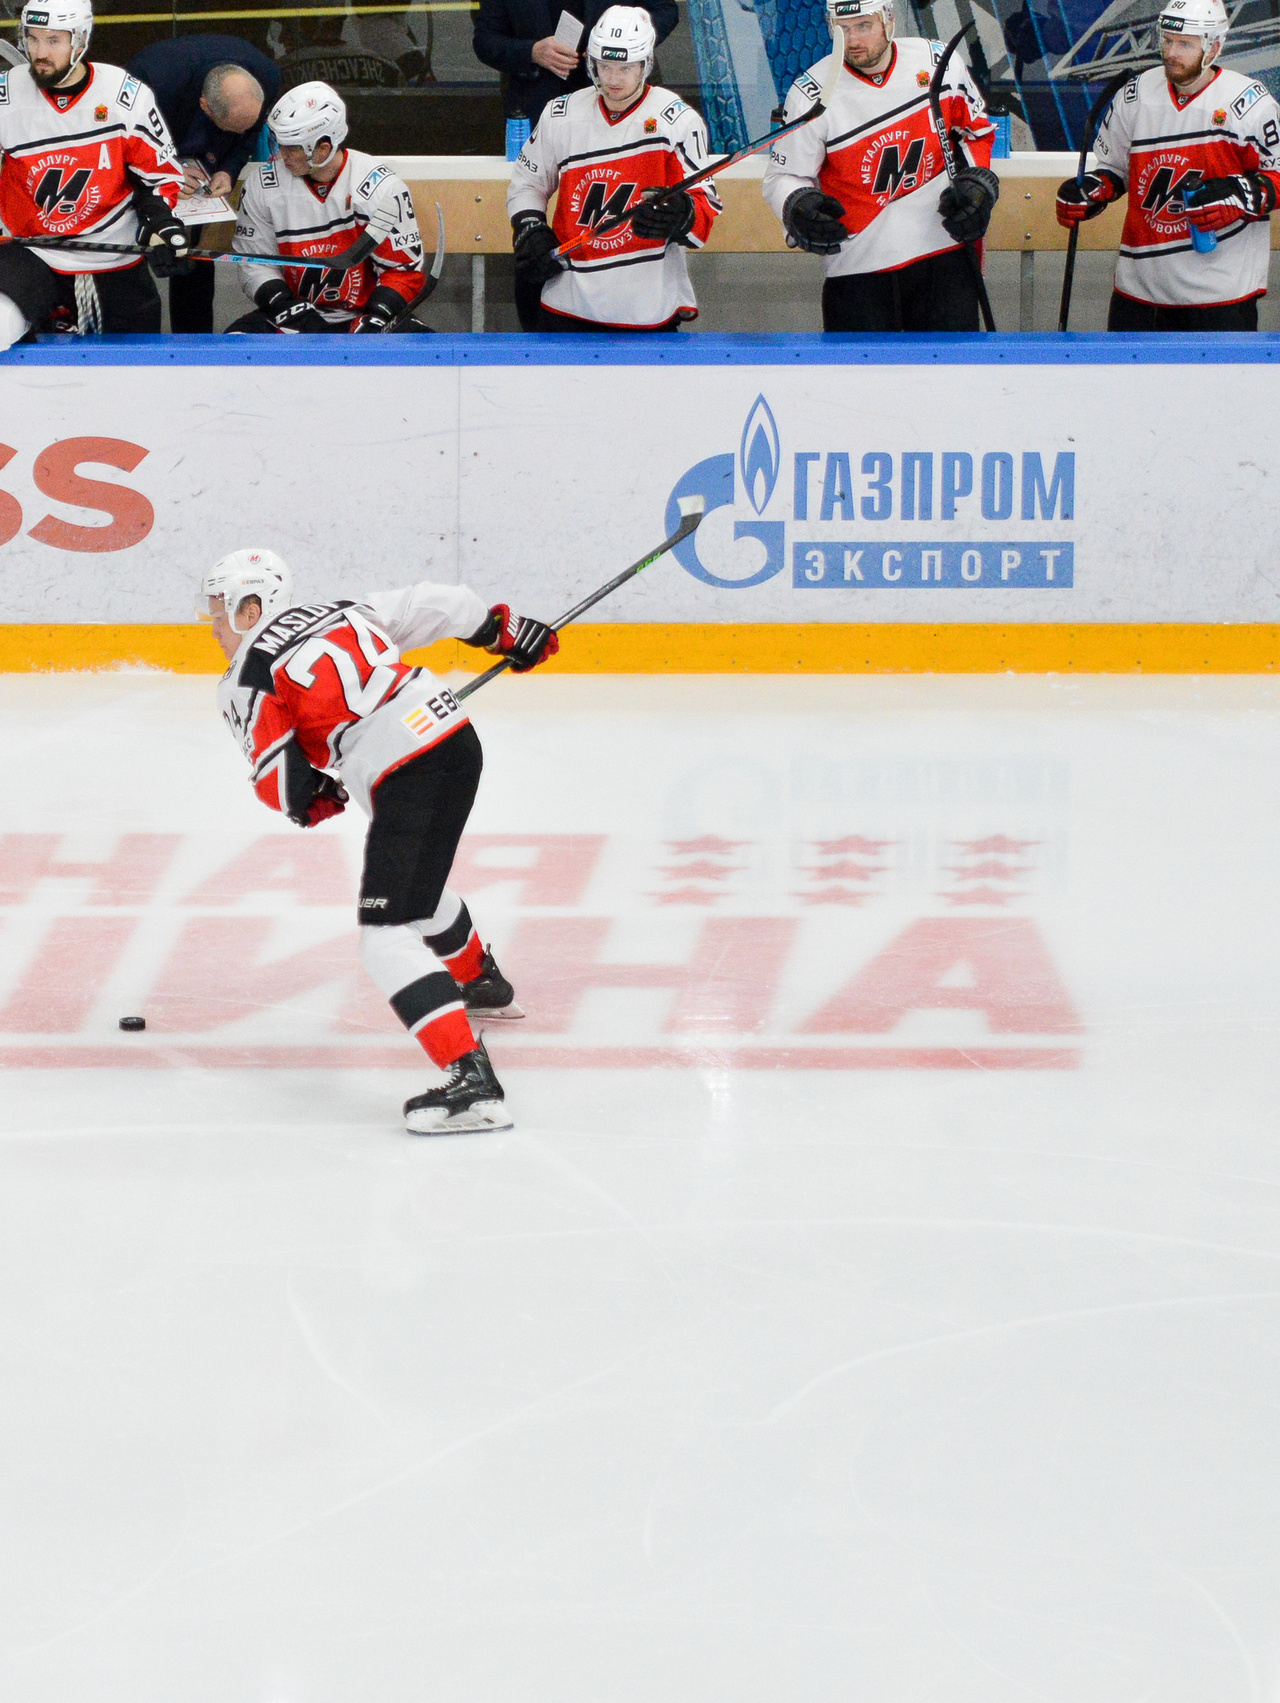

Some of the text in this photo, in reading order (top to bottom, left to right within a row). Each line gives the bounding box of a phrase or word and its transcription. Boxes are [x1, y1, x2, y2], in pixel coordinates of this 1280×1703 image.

[27, 14, 48, 23] PARI
[836, 3, 859, 13] PARI
[1162, 18, 1183, 28] PARI
[610, 27, 622, 38] 10
[603, 50, 627, 58] PARI
[98, 143, 111, 170] A
[862, 130, 910, 185] МЕТАЛЛУРГ
[570, 168, 622, 212] МЕТАЛЛУРГ
[1136, 153, 1190, 196] МЕТАЛЛУРГ
[37, 185, 102, 233] НОВОКУЗНЕЦК
[394, 190, 415, 223] 13
[792, 451, 1076, 521] ГАЗПРОМ
[805, 551, 1063, 583] ЭКСПОРТ
[283, 608, 401, 719] 24
[425, 688, 461, 721] ЕВ
